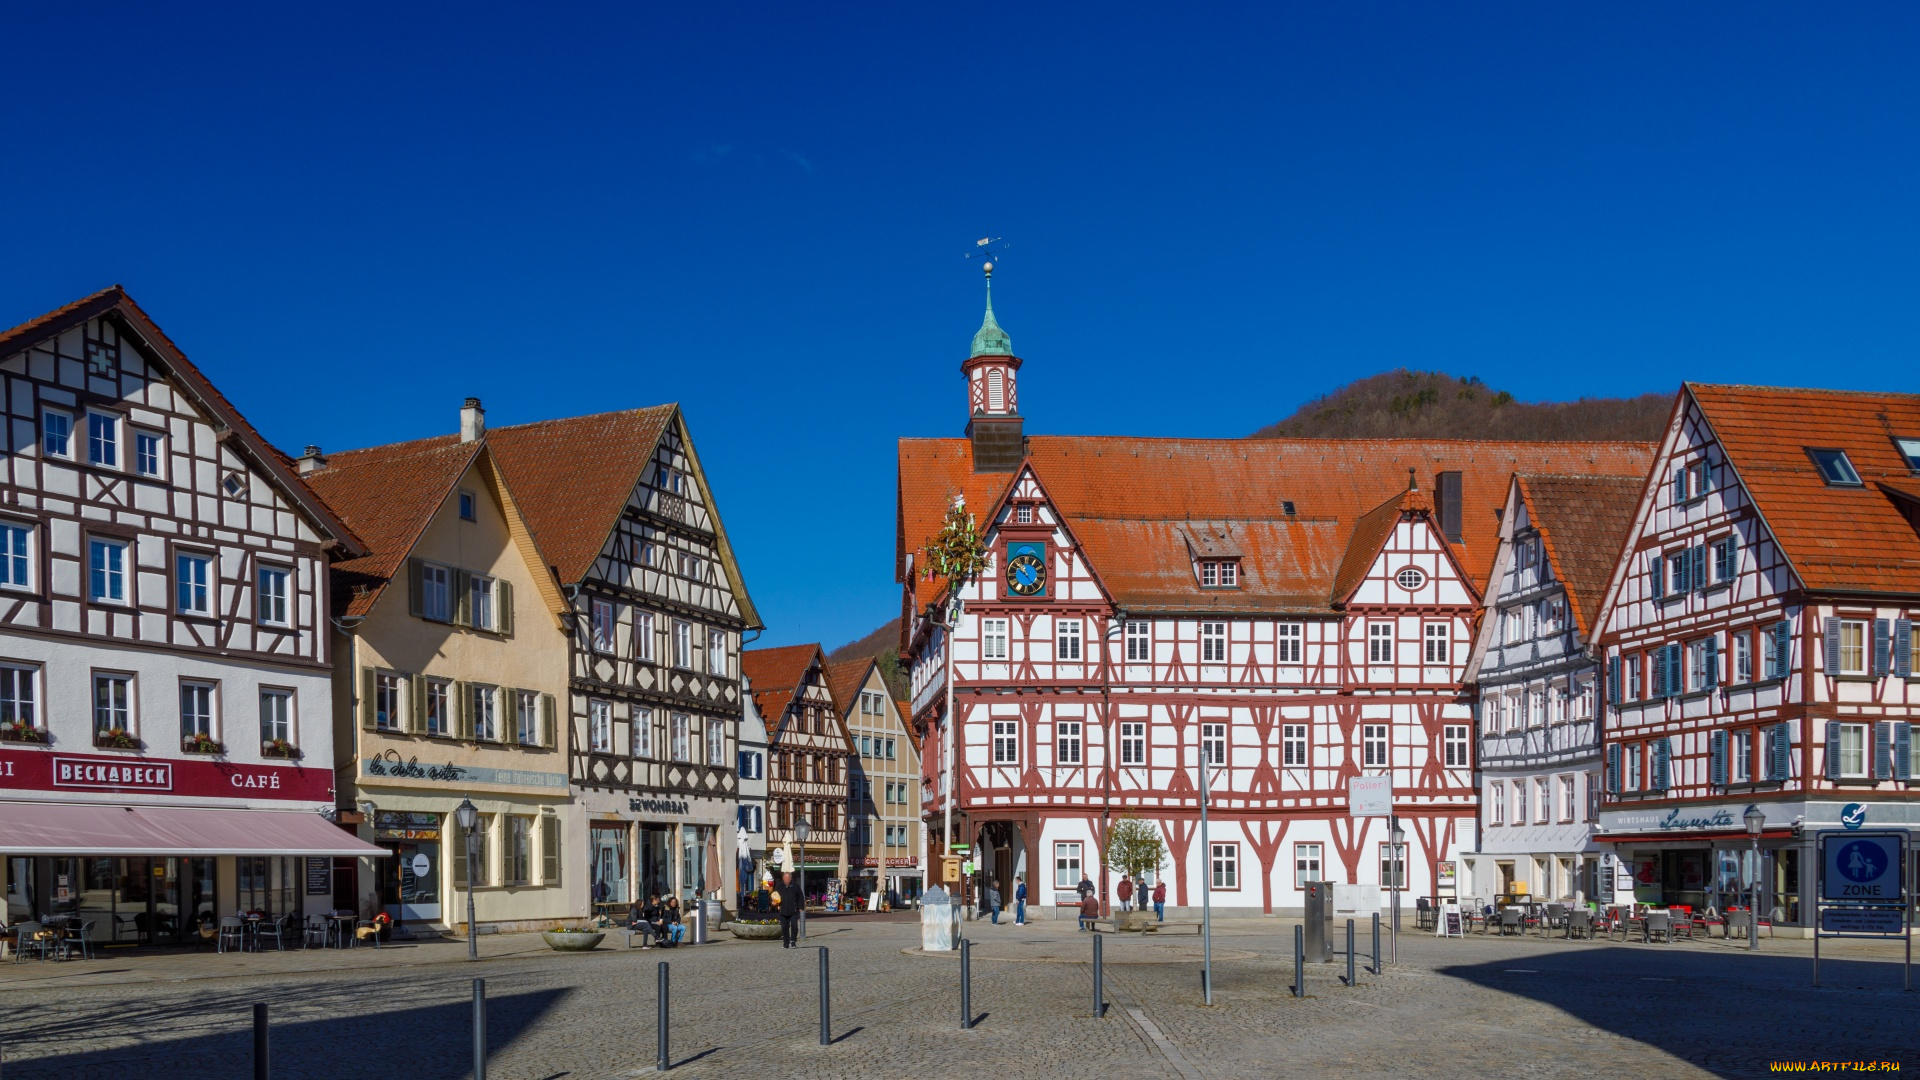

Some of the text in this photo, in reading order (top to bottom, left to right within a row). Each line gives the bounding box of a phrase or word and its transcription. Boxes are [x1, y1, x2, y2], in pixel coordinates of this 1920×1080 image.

[61, 764, 165, 783] BECKABECK
[231, 772, 280, 788] CAFÉ
[1617, 815, 1660, 824] WIRTSHAUS
[1843, 885, 1881, 895] ZONE
